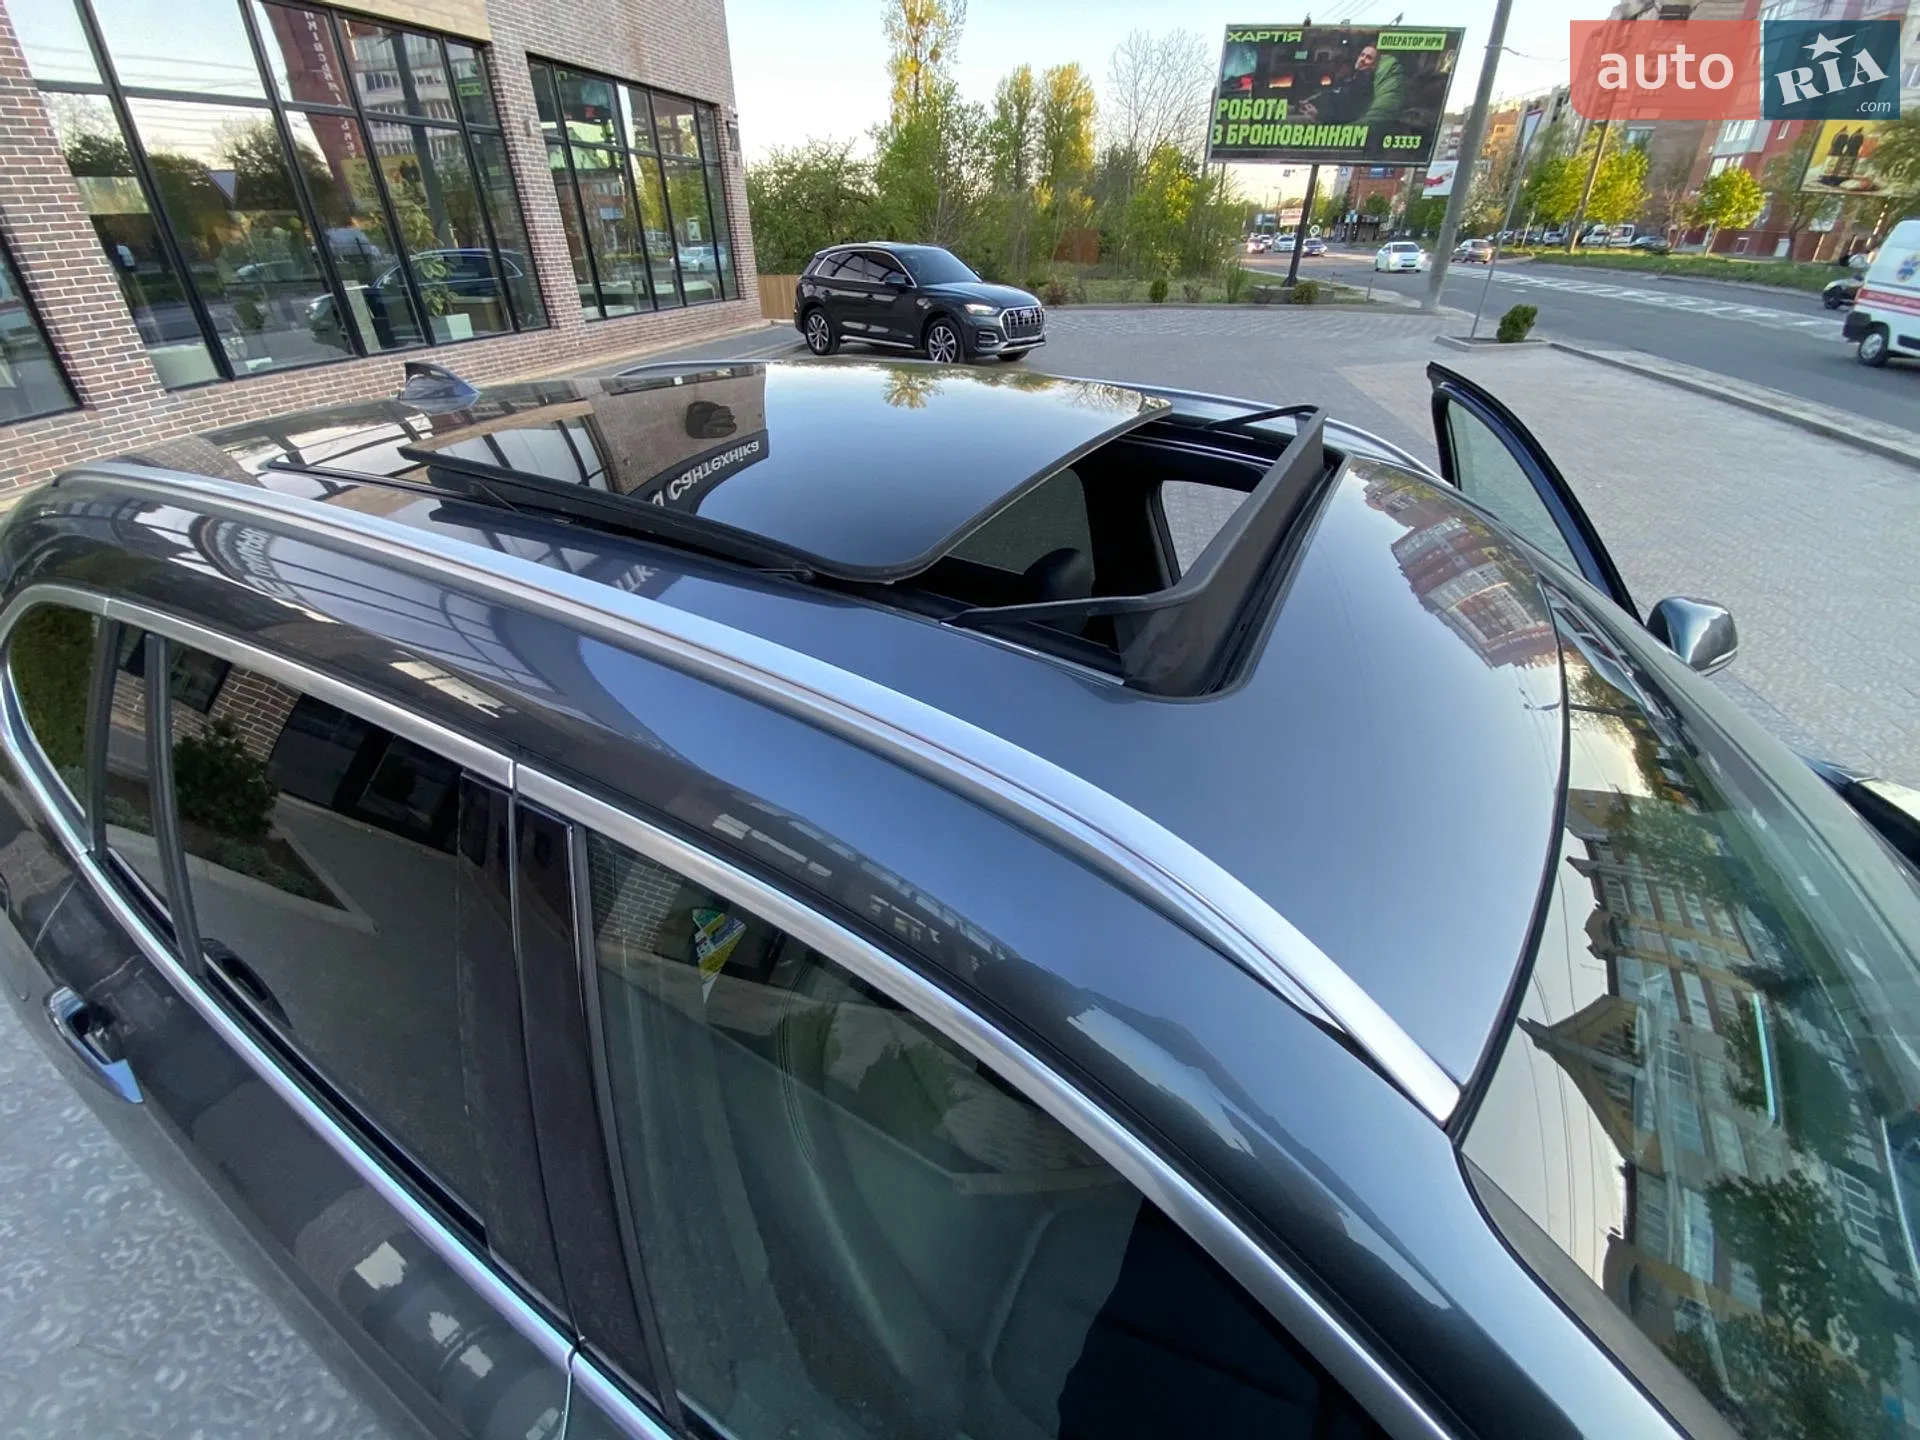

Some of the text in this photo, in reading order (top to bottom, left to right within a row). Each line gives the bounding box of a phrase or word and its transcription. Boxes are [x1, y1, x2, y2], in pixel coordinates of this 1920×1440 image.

[1226, 30, 1303, 43] ХАРТІЯ
[1381, 35, 1424, 47] ОПЕРАТОР
[1216, 98, 1289, 121] РОБОТА
[1212, 124, 1369, 147] З БРОНЮВАННЯМ
[1392, 135, 1422, 149] 3333
